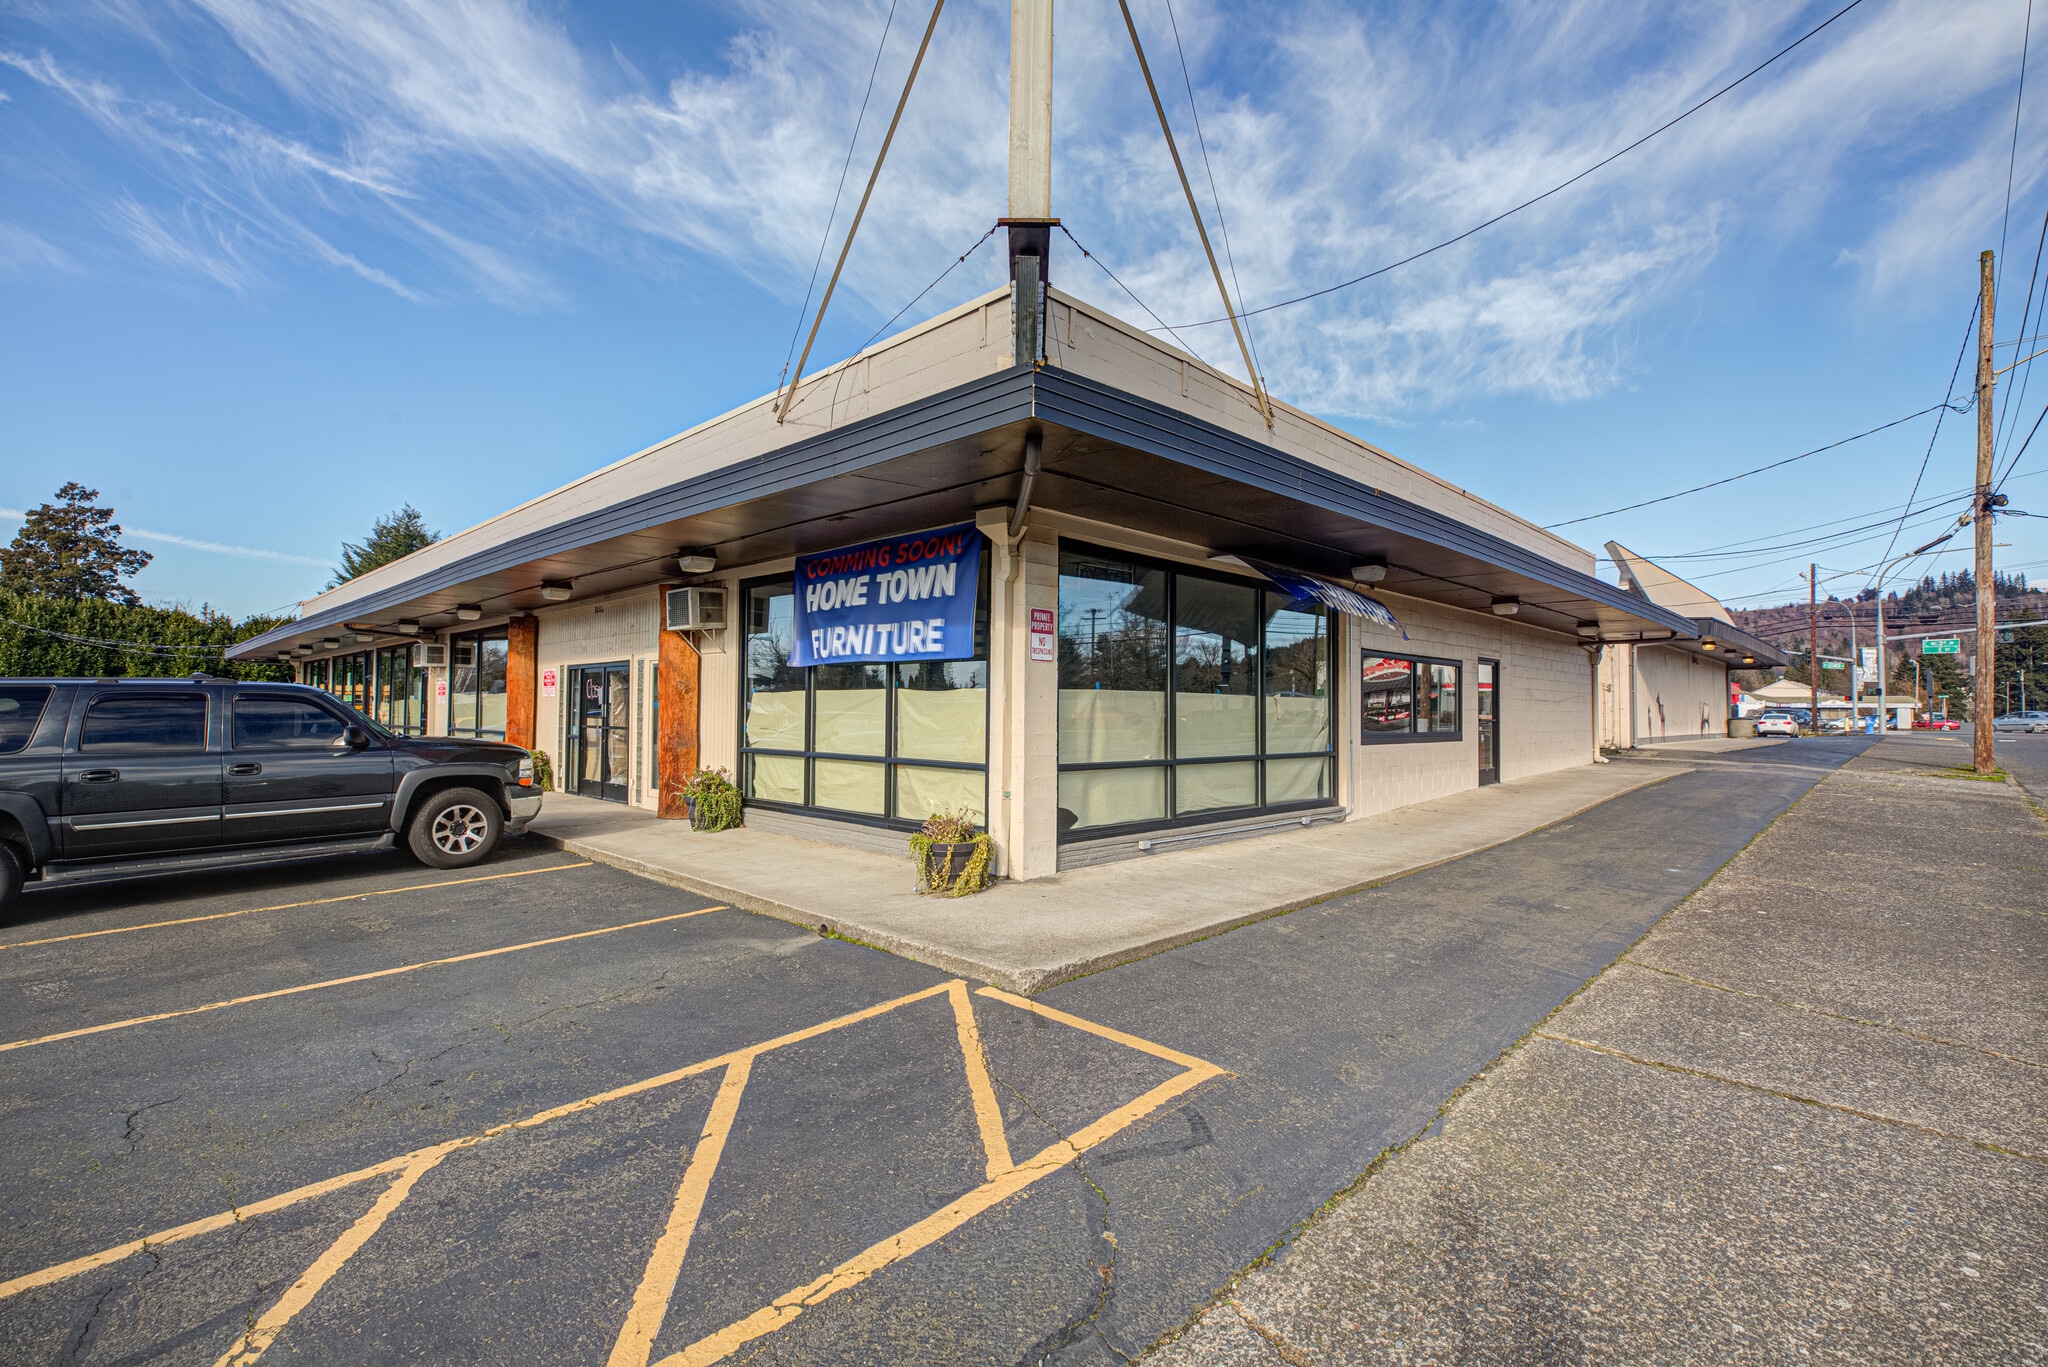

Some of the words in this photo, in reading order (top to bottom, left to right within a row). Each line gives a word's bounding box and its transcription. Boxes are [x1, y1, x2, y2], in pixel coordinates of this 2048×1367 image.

[807, 546, 890, 579] COMMING
[895, 535, 963, 564] SOON!
[806, 574, 871, 613] HOME
[876, 562, 957, 605] TOWN
[1031, 621, 1053, 631] PROPERTY
[1033, 612, 1051, 622] PRIVATE
[811, 618, 946, 659] FURNITURE
[1038, 636, 1046, 647] NO
